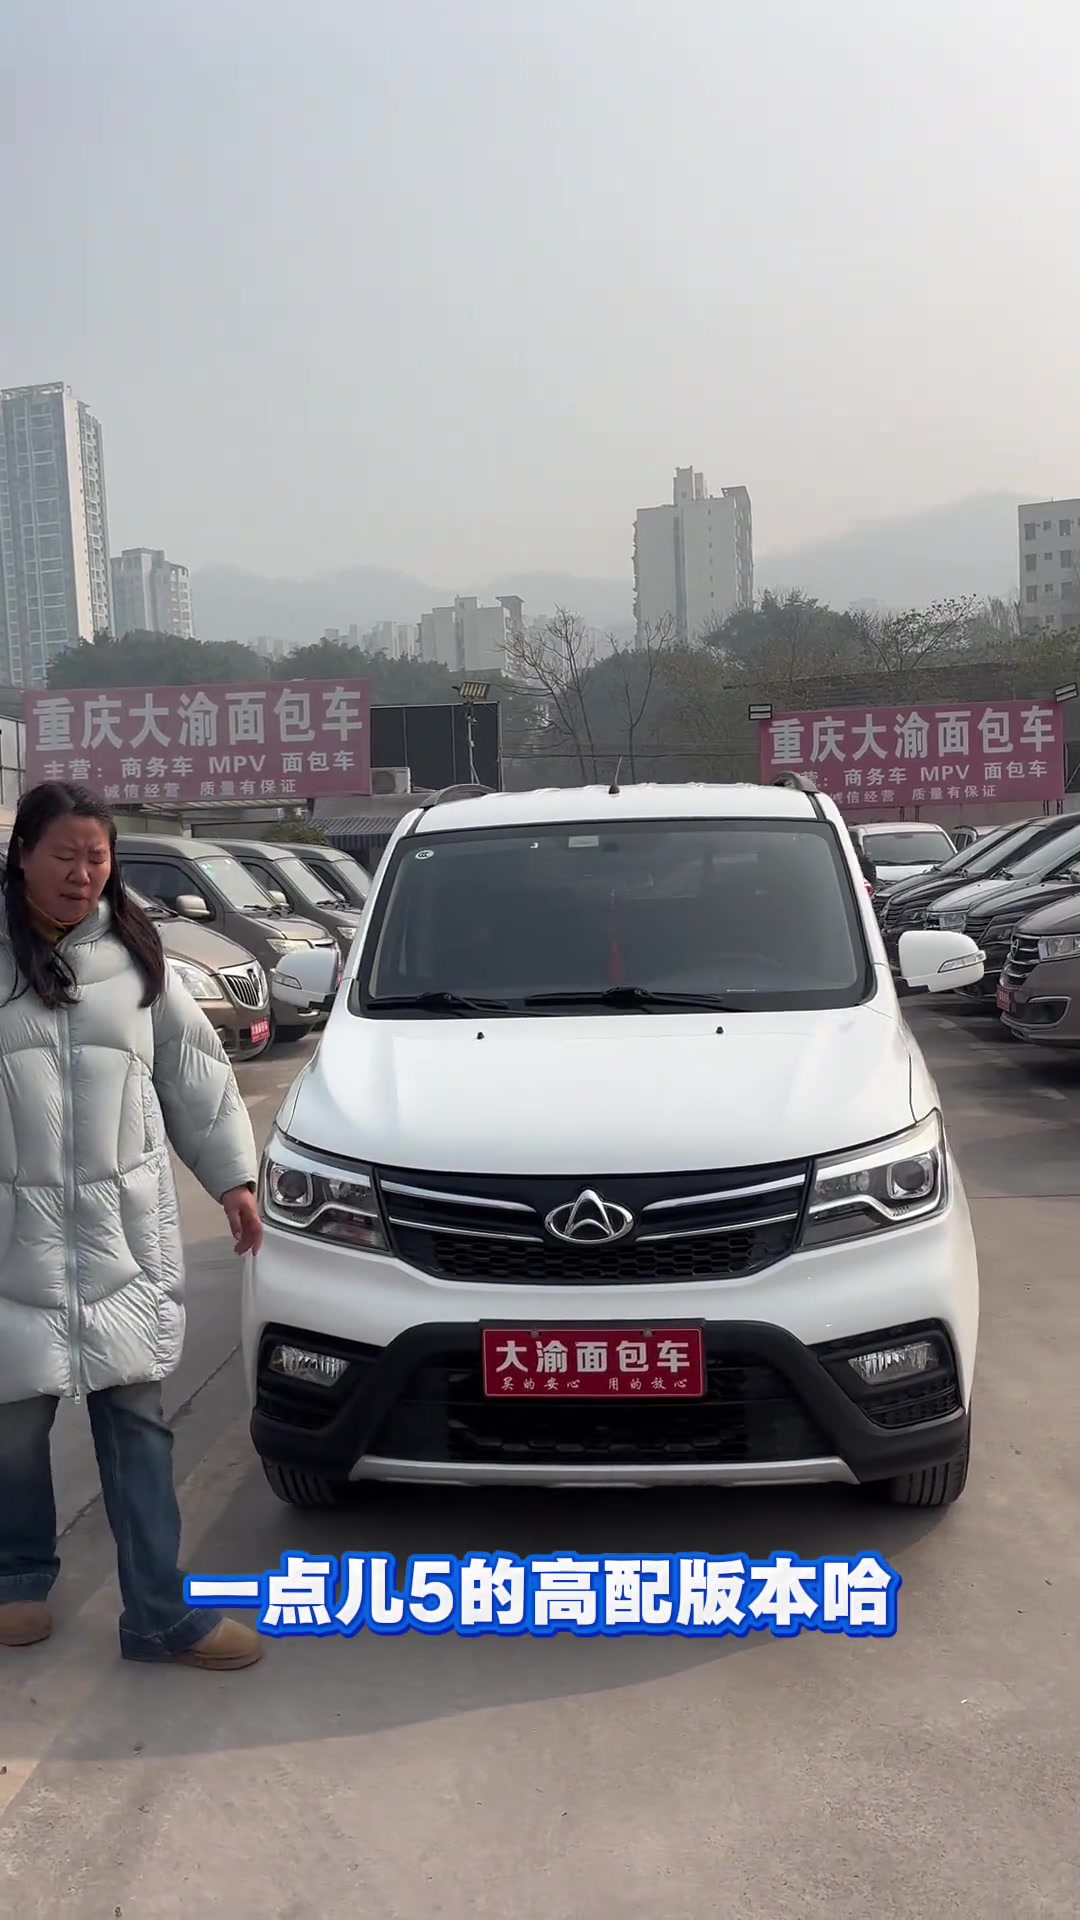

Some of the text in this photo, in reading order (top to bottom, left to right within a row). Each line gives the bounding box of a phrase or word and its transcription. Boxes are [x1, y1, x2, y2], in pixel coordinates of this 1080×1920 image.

[33, 686, 363, 752] 重庆大渝面包车
[769, 705, 1055, 765] 重庆大渝面包车
[120, 756, 194, 779] 商务车
[209, 755, 266, 774] MPV
[281, 750, 356, 773] 面包车
[844, 767, 908, 787] 商务车
[920, 765, 971, 782] MPV
[984, 759, 1048, 780] 面包车
[103, 778, 297, 799] 诚信经营 质量有保证
[911, 785, 997, 801] 质量有保证
[495, 1340, 690, 1373] 大渝面包车
[500, 1376, 688, 1391] 买的安心 用的放心
